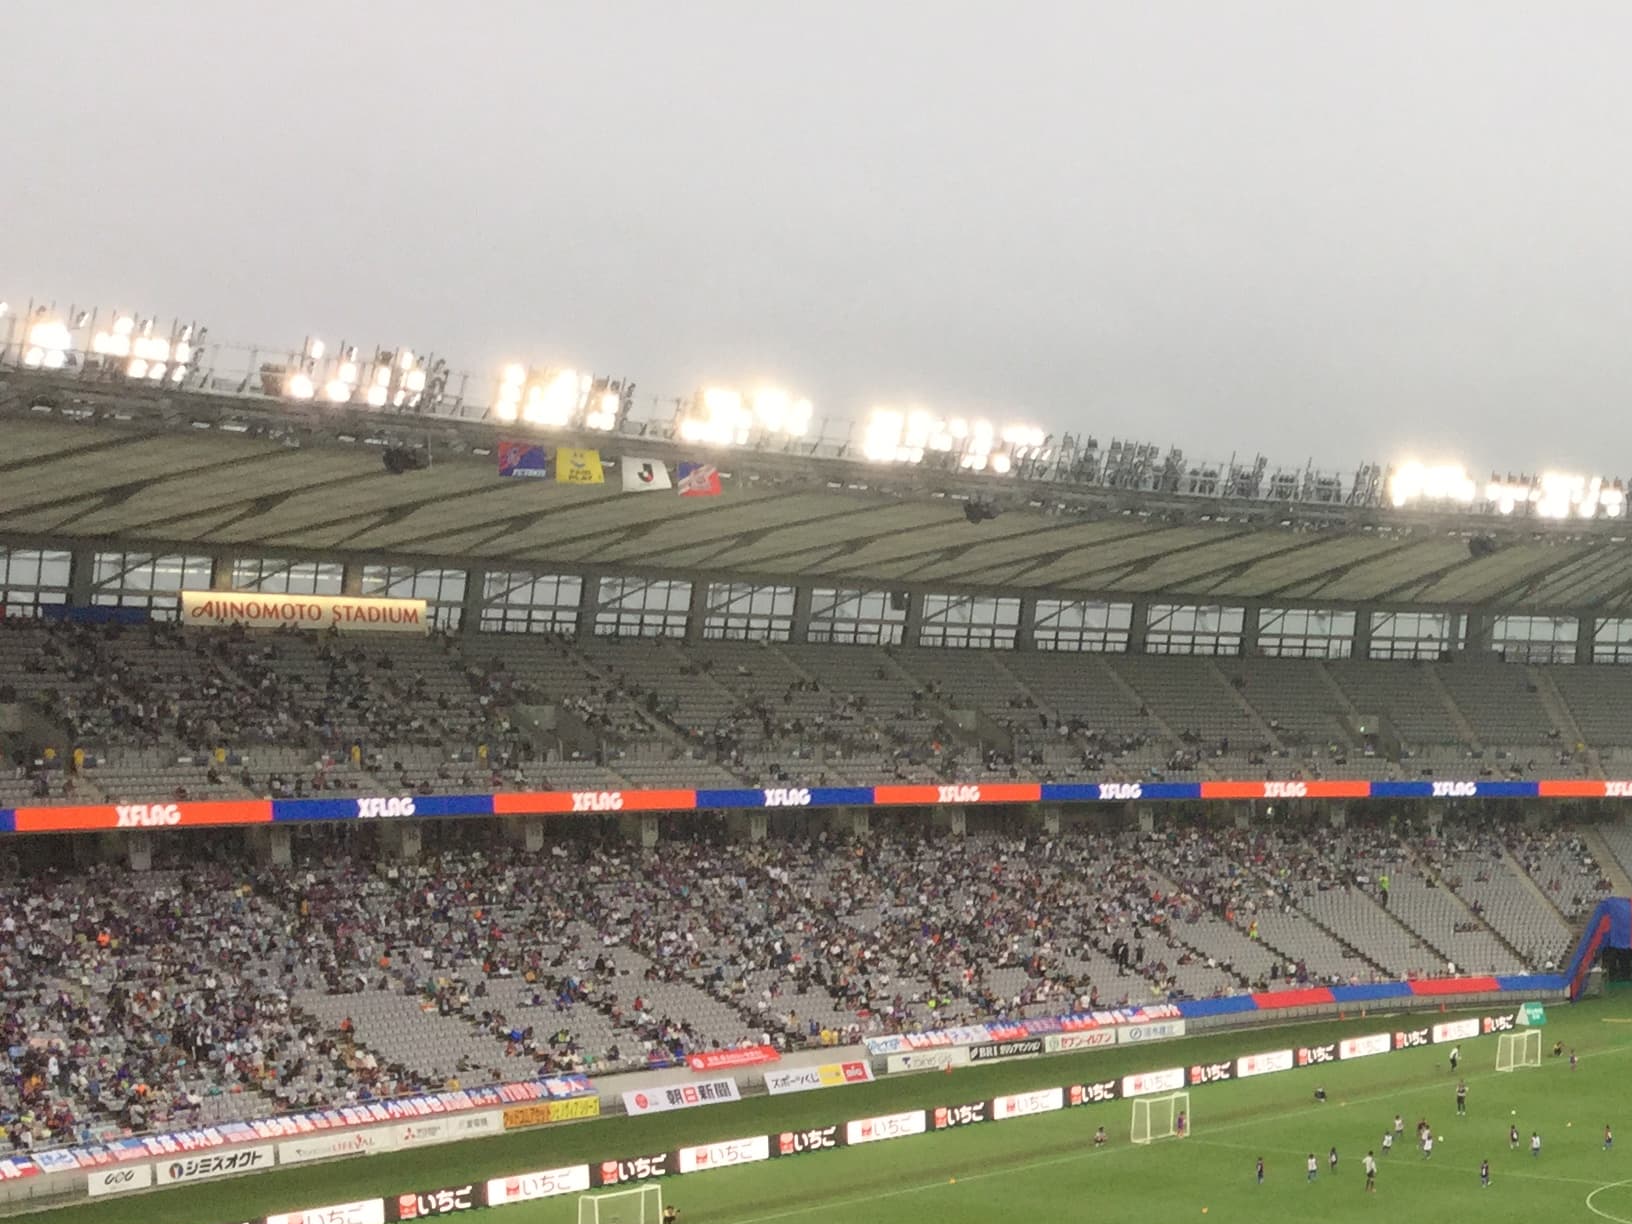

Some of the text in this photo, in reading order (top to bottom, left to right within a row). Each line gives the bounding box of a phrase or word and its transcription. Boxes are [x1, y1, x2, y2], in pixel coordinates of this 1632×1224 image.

[192, 600, 419, 624] AJINOMOTO STADIUM
[765, 788, 811, 806] XFLAG
[938, 785, 980, 803] XFLAG
[1099, 783, 1142, 801] XFLAG
[1264, 781, 1307, 798] XFLAG
[1433, 781, 1476, 798] XFLAG
[357, 797, 416, 818] XFLAG
[572, 792, 623, 812] XFLAG
[116, 805, 181, 826] XFLAG
[1403, 1028, 1428, 1047] いちご
[1306, 1044, 1335, 1065] いちご
[1200, 1061, 1231, 1082] いちご
[666, 1080, 732, 1105] 朝日新聞
[1014, 1092, 1051, 1112] いちご
[1082, 1081, 1115, 1103] いちご
[947, 1102, 985, 1125] いちご
[872, 1114, 914, 1138] いちご
[794, 1125, 837, 1152] いちご
[709, 1139, 753, 1163] いちご
[186, 1150, 262, 1176] シミズオクト
[618, 1153, 667, 1181] いちご
[523, 1170, 572, 1196] いちご
[417, 1185, 473, 1215] いちご
